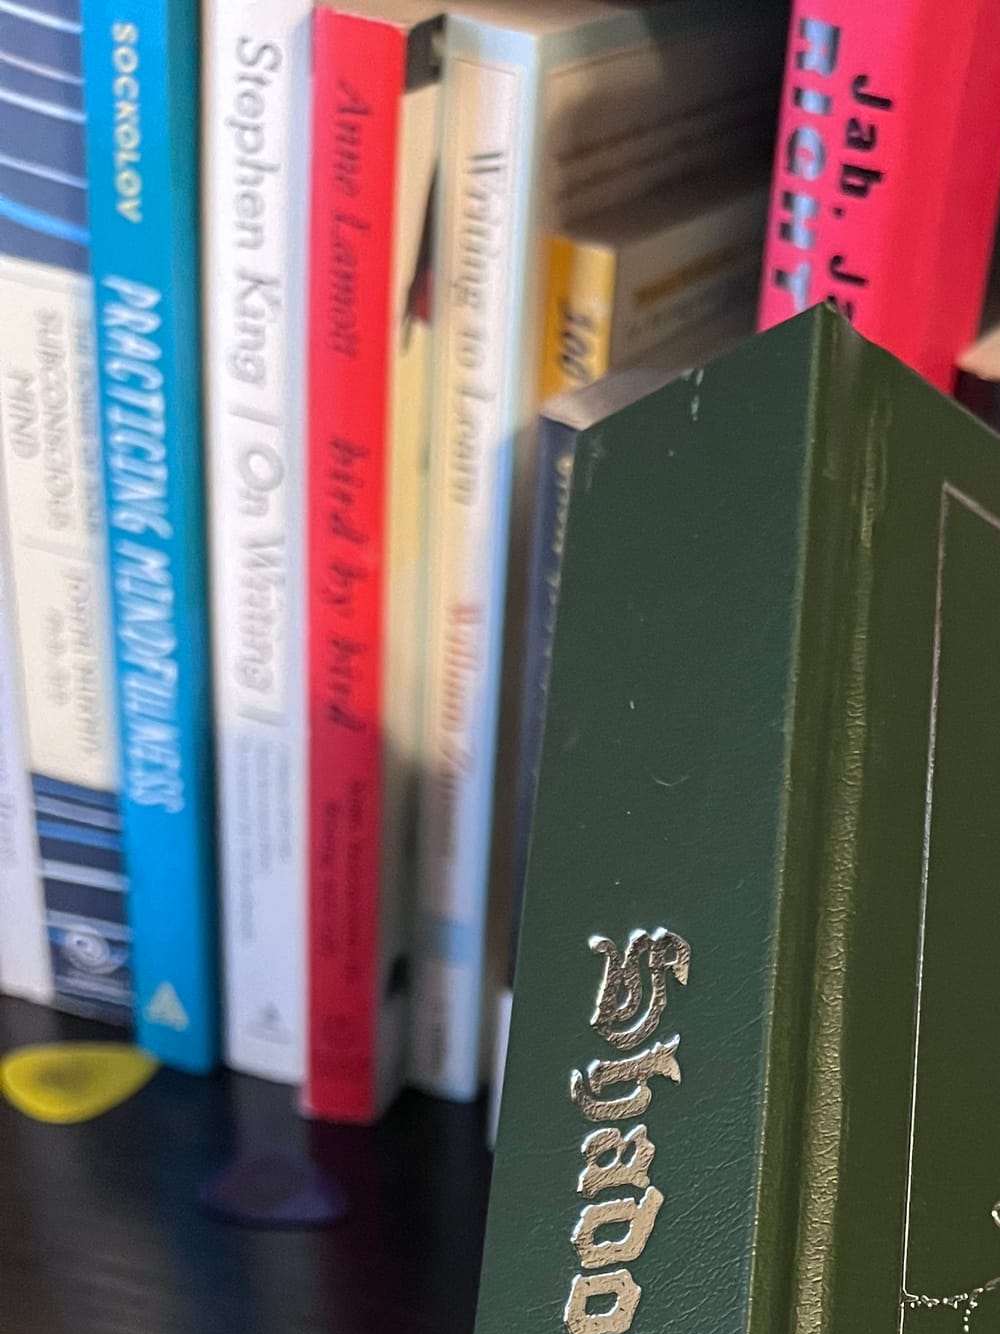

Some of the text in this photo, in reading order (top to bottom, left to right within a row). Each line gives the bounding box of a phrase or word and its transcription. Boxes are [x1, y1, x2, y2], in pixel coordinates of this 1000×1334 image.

[225, 35, 283, 255] Stephen
[228, 267, 283, 386] King
[101, 274, 184, 813] PRACTICING MINDFULNESS
[234, 443, 285, 518] On
[235, 537, 286, 696] Writing
